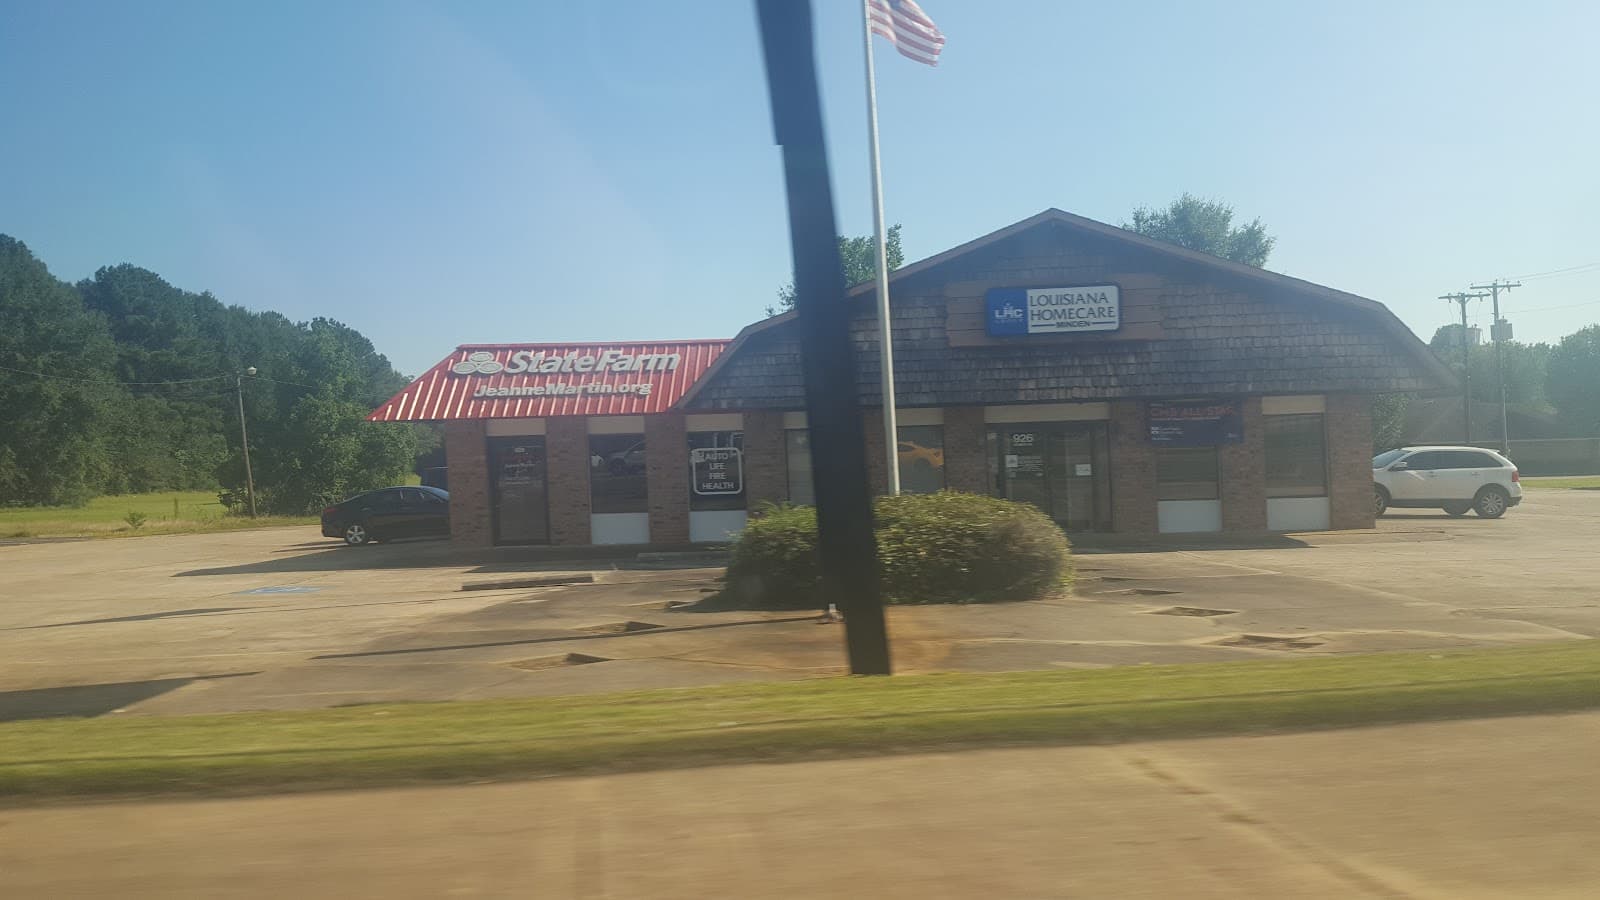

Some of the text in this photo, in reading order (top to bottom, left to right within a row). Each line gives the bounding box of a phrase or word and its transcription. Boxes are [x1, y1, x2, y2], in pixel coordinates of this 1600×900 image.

[1030, 292, 1109, 307] LOUISIANA
[1030, 306, 1116, 321] HOMECARE
[474, 382, 653, 398] JeanneMartin.org
[1012, 433, 1034, 443] 926
[705, 452, 729, 460] AUTO
[709, 472, 727, 480] FIRE
[702, 482, 734, 490] HEALTH
